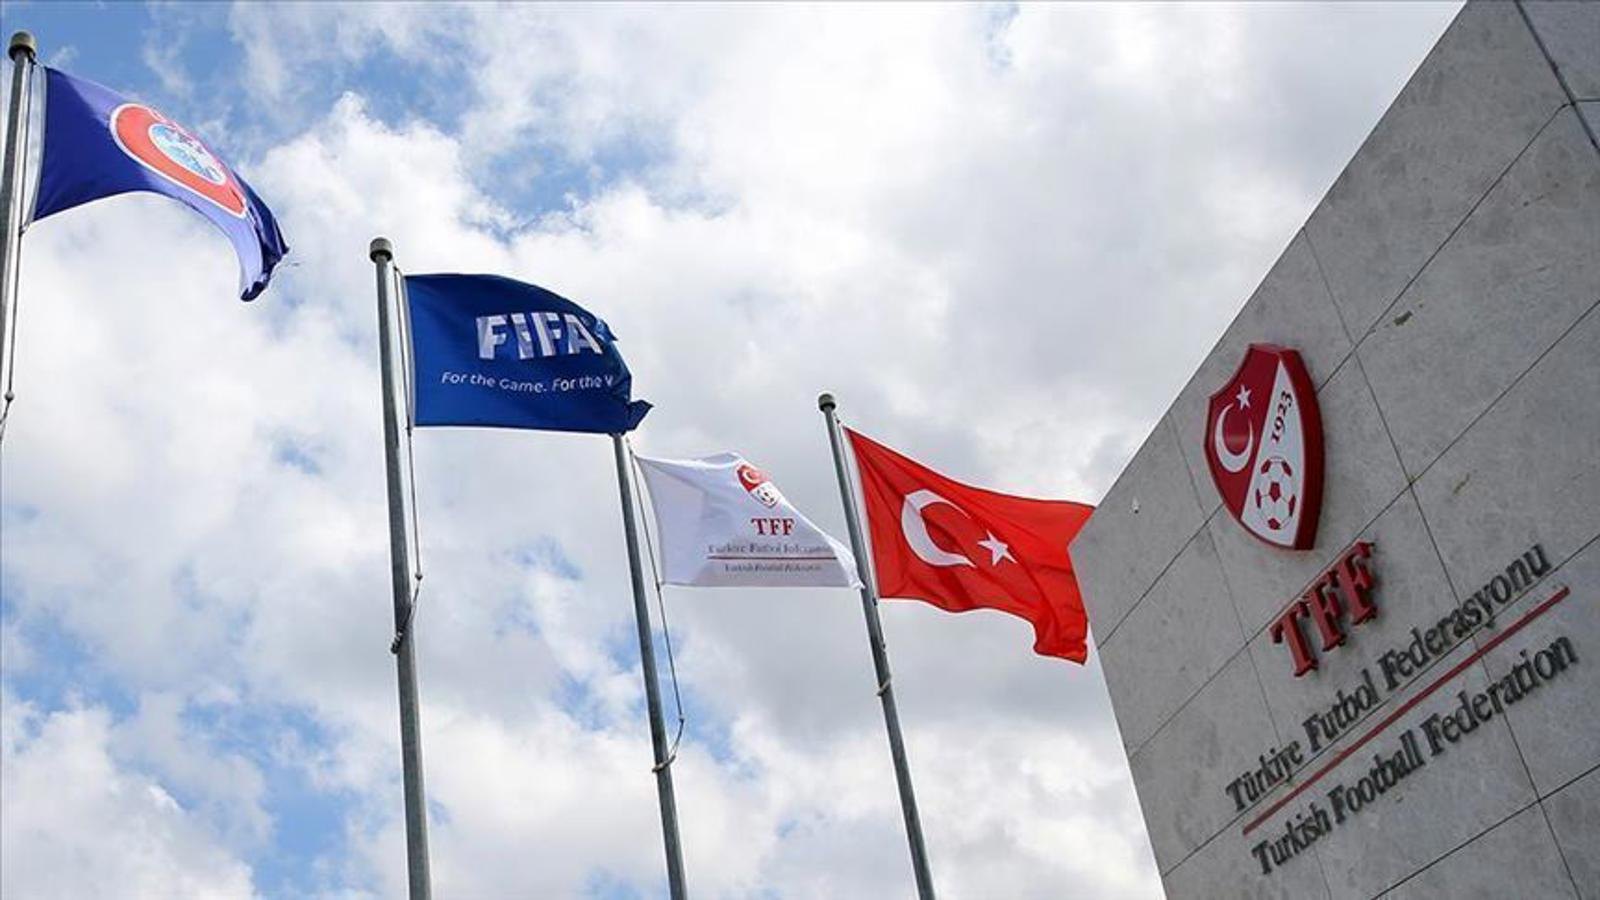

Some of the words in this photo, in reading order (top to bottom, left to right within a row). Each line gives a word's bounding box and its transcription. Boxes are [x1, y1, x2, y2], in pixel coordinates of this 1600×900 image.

[475, 312, 603, 360] FIFA
[441, 371, 466, 385] For
[470, 374, 496, 388] the
[499, 378, 548, 394] Game.
[552, 377, 576, 392] For
[578, 375, 603, 390] the
[1271, 390, 1294, 443] 1923
[751, 518, 795, 536] TFF
[1268, 539, 1378, 677] TFF
[1225, 740, 1304, 812] Türkiye
[1302, 668, 1382, 752] Futbol
[1377, 543, 1552, 691] Federasyonu
[1251, 801, 1333, 875] Turkish
[1327, 729, 1426, 824] Football
[1420, 636, 1579, 756] Federation
